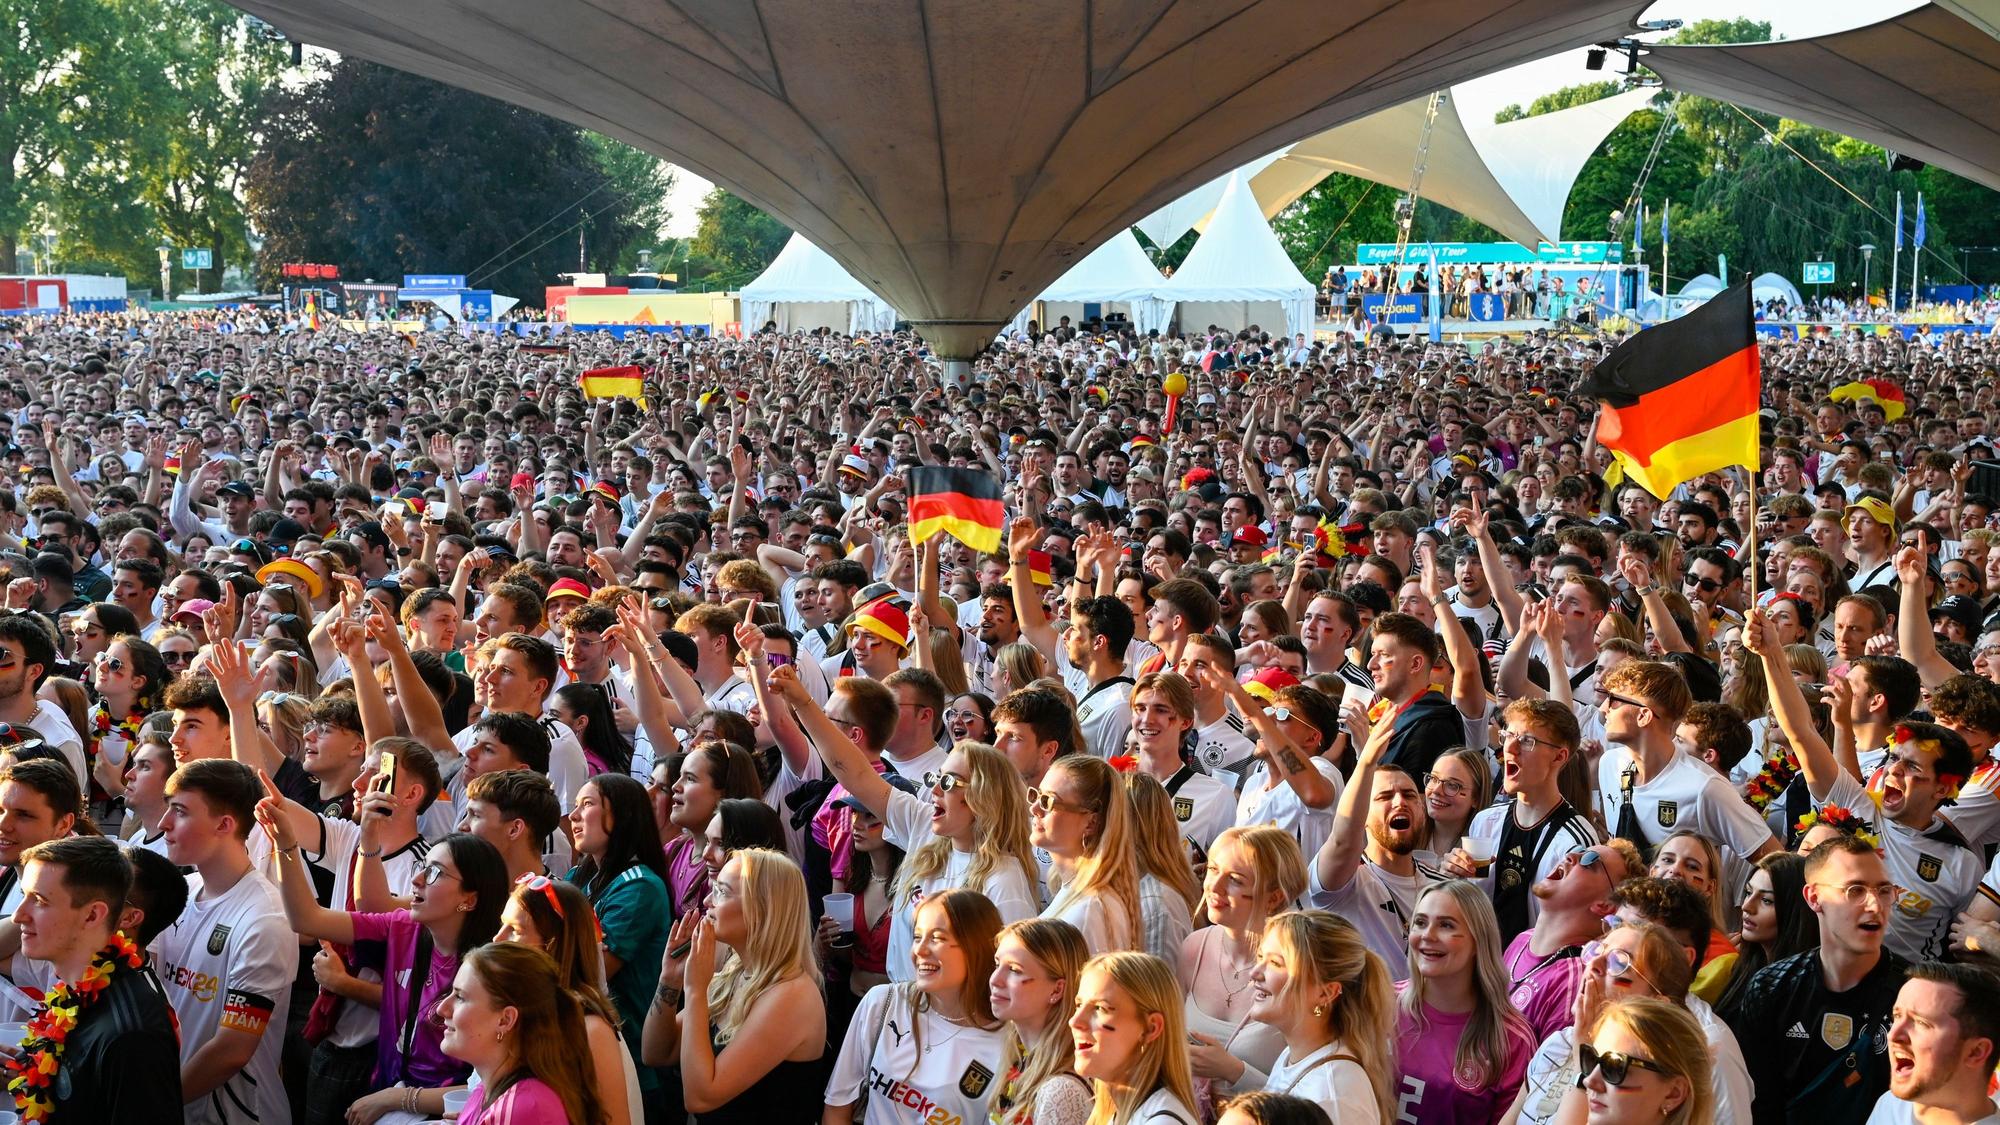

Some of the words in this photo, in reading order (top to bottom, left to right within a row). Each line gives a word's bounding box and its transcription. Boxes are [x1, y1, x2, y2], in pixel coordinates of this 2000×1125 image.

[1368, 247, 1403, 260] Beyo
[1409, 247, 1440, 258] Gloy
[1442, 246, 1468, 257] Tour
[1786, 1031, 1810, 1039] adidas
